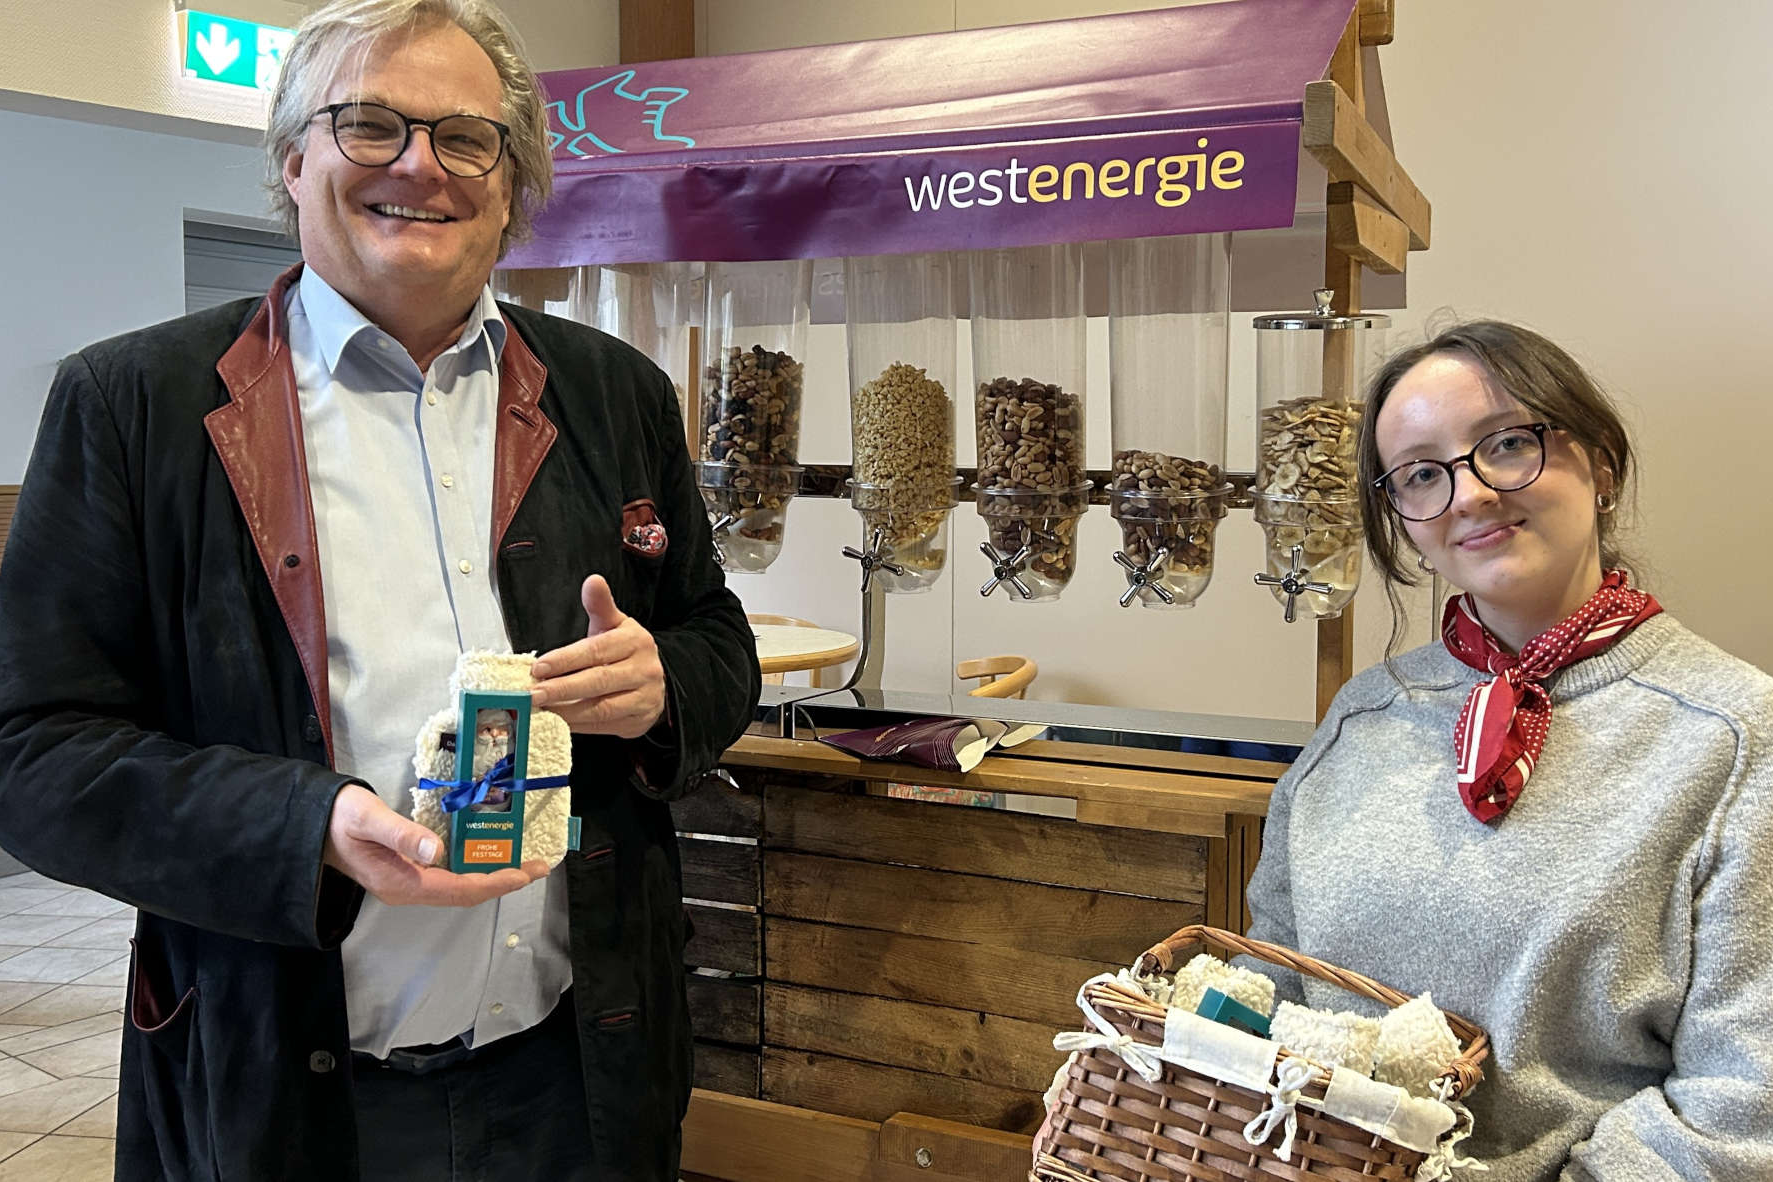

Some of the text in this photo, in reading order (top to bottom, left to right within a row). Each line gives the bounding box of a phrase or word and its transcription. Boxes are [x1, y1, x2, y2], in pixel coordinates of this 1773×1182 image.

[904, 137, 1246, 212] westenergie
[465, 821, 515, 831] westenergie
[477, 843, 498, 851] FROHE
